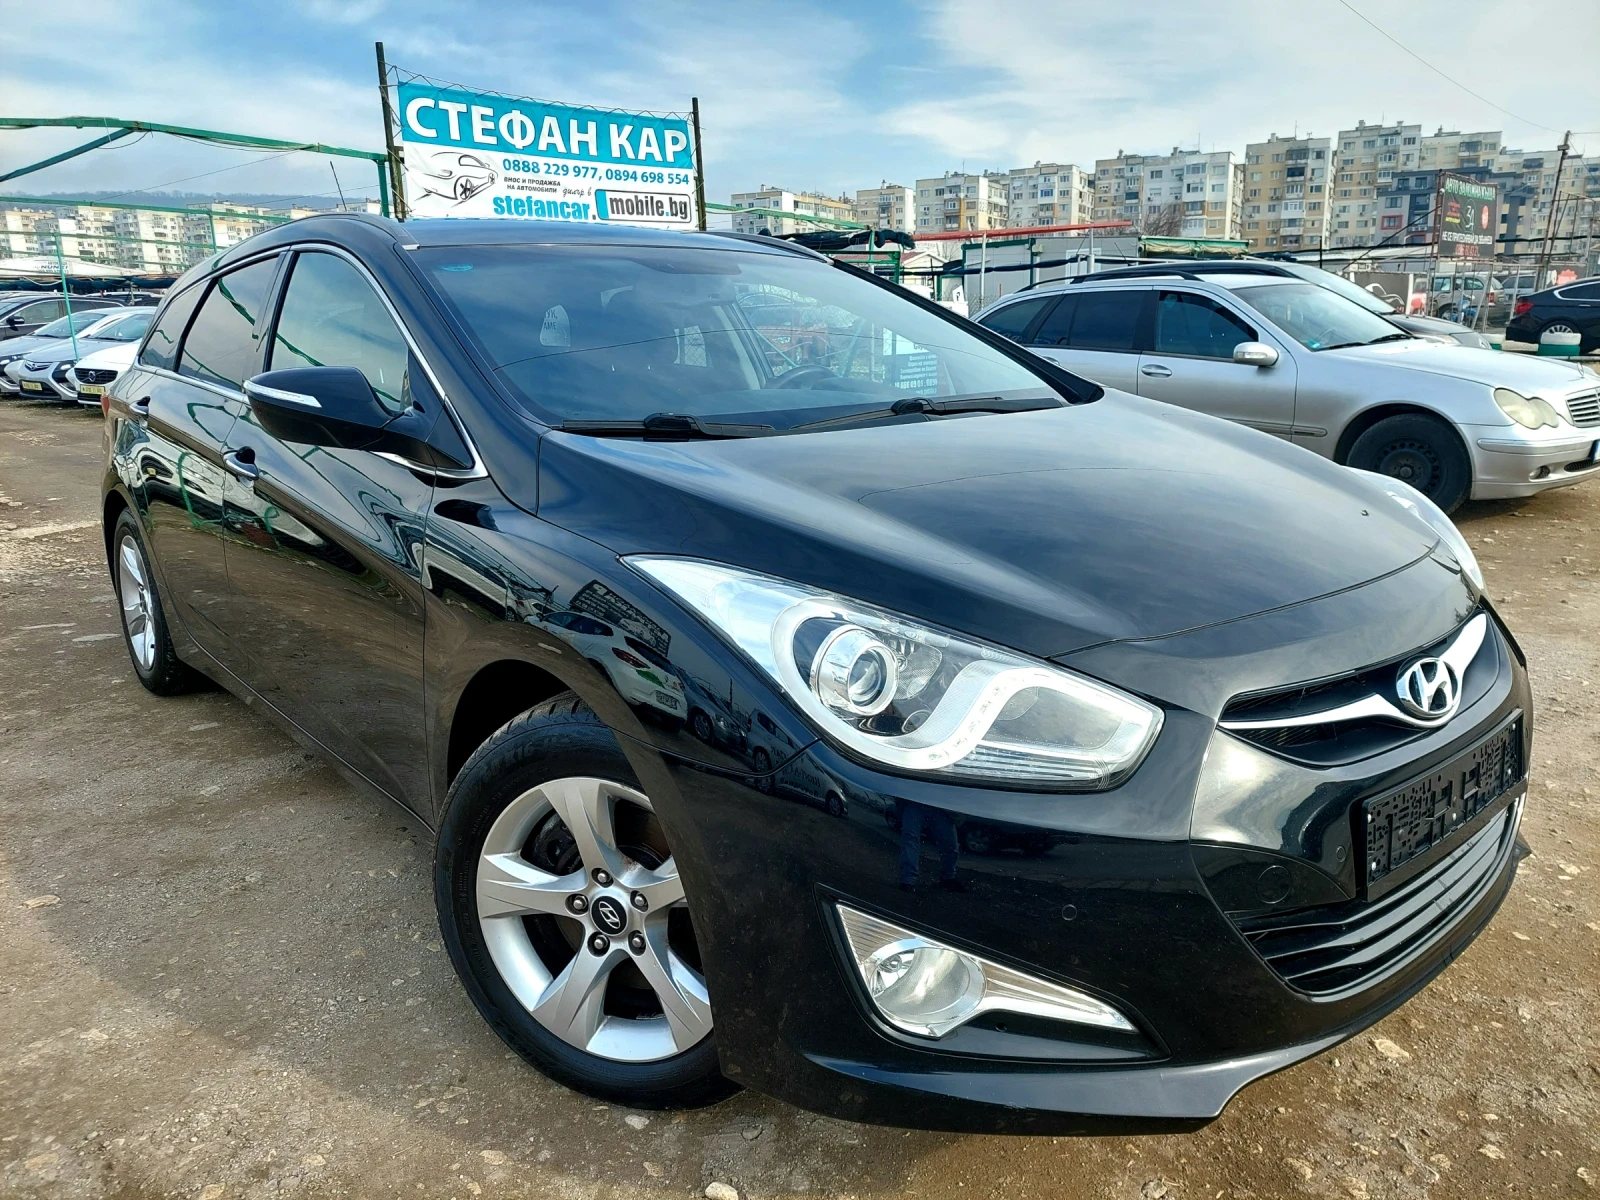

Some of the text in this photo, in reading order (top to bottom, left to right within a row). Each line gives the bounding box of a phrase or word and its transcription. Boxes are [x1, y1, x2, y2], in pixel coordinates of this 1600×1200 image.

[405, 97, 687, 163] СТЕФАН КАР
[502, 158, 690, 185] 0888 229 977, 0894 698 554
[527, 178, 561, 187] ПРОДАЖБА
[516, 185, 557, 193] АВТОМОБИЛИ
[608, 195, 688, 219] mobile.bg
